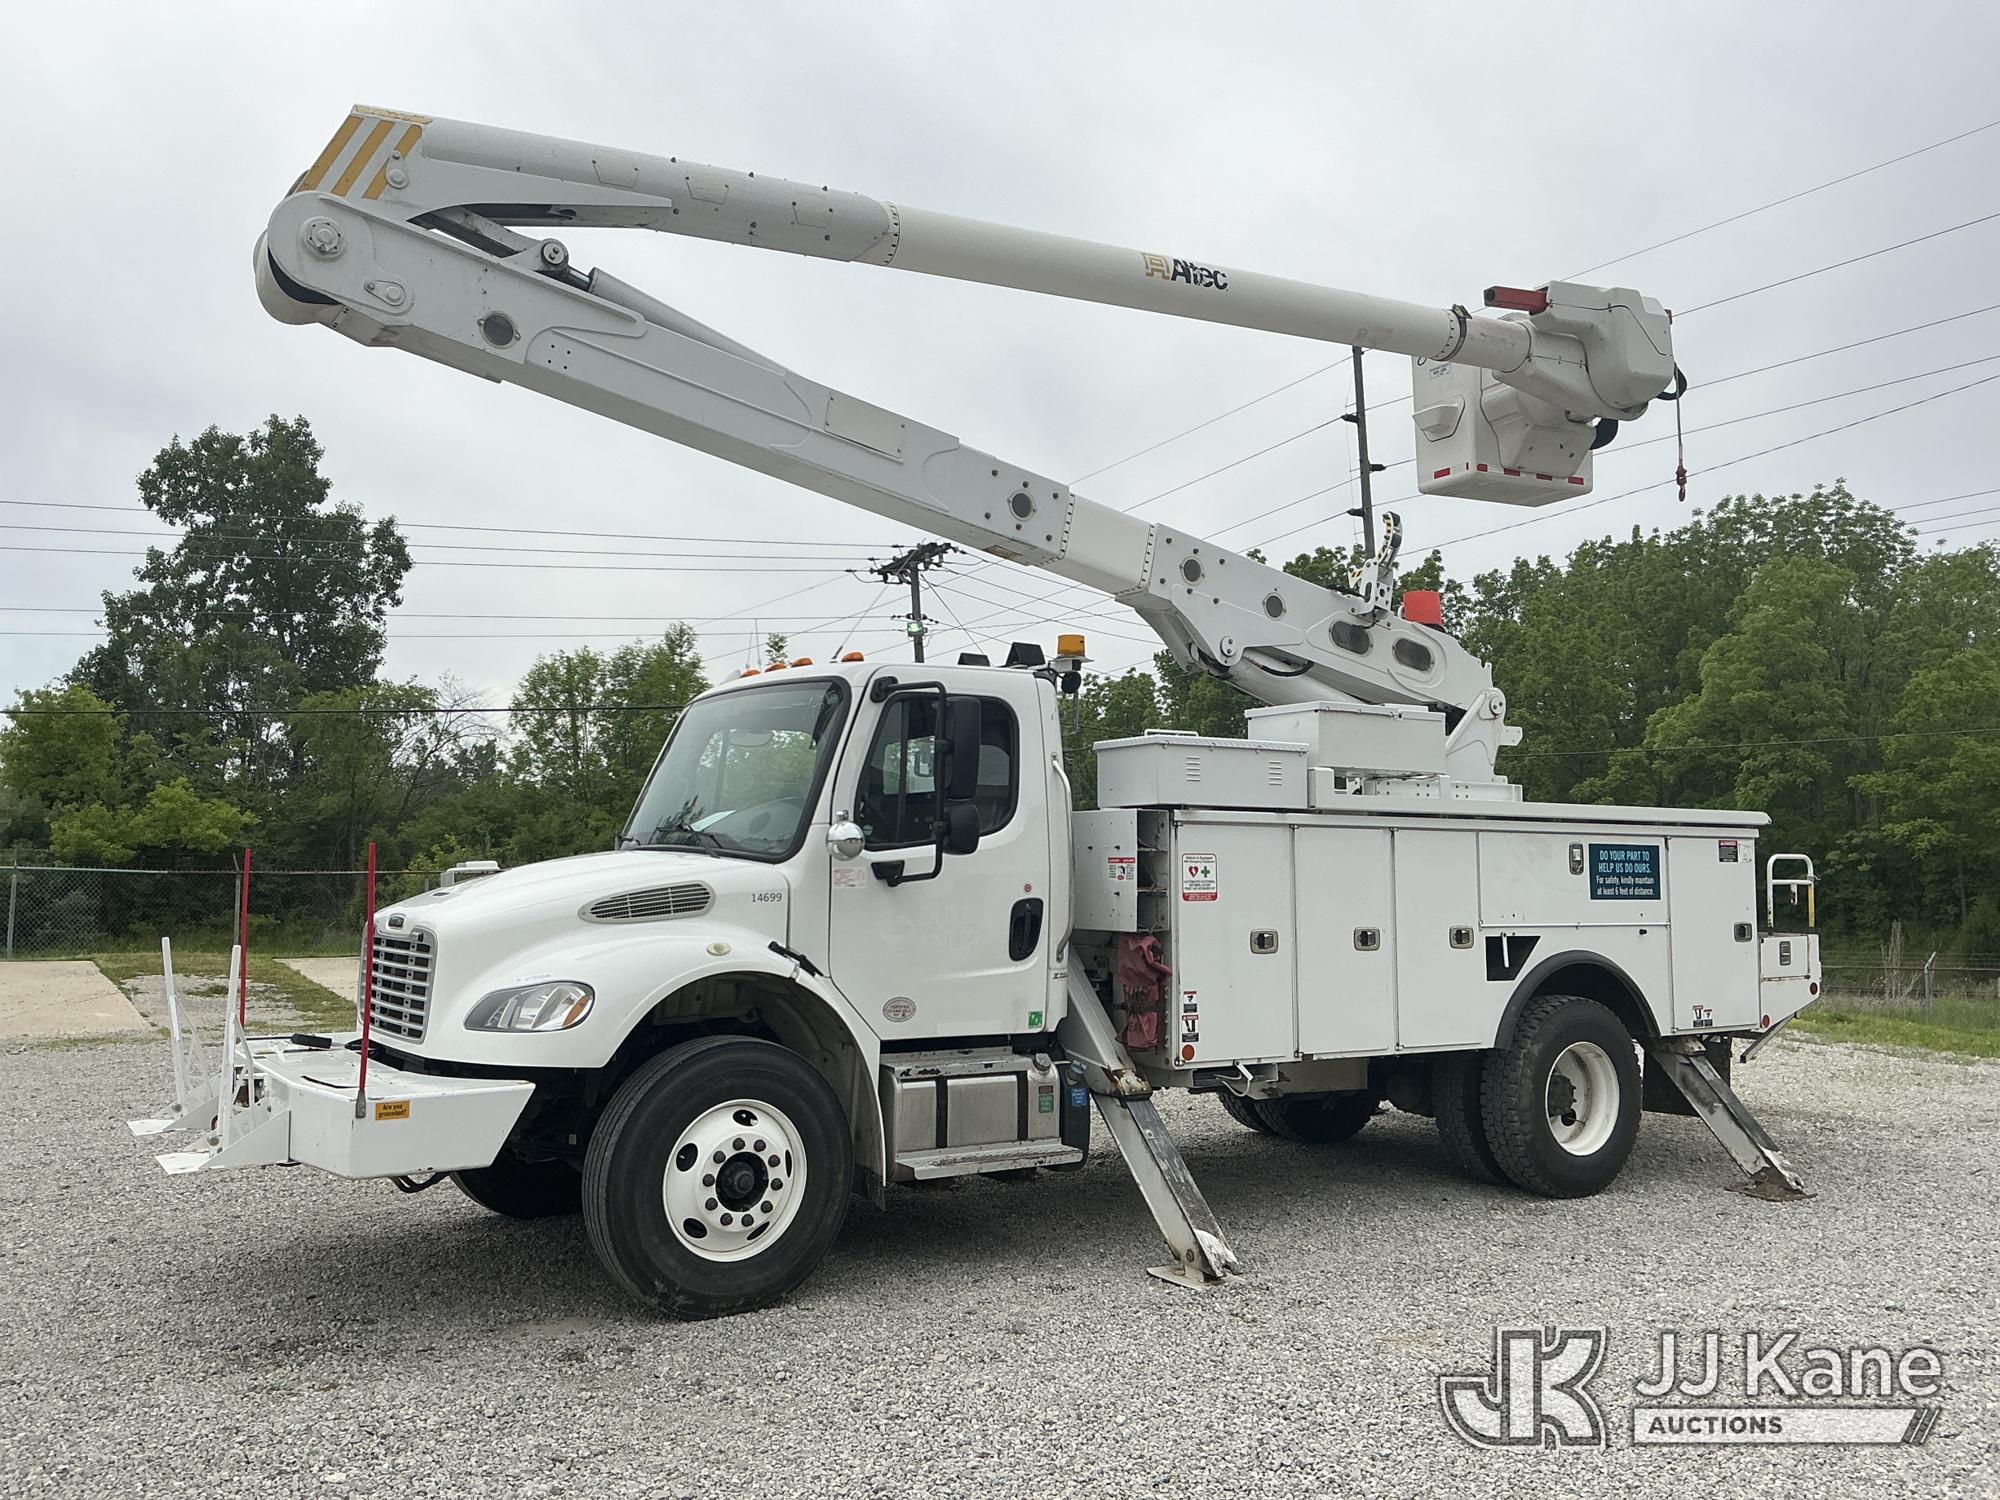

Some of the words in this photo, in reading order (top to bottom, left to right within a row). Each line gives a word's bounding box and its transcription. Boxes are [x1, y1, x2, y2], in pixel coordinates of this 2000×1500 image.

[1599, 850, 1608, 861] DO
[1609, 850, 1625, 861] YOUR
[1626, 850, 1641, 861] PART
[1642, 851, 1649, 861] TO
[1598, 862, 1614, 872] HELP
[1615, 862, 1623, 873] US
[1624, 862, 1633, 873] DO
[1596, 875, 1604, 884] For
[751, 892, 783, 903] 14699
